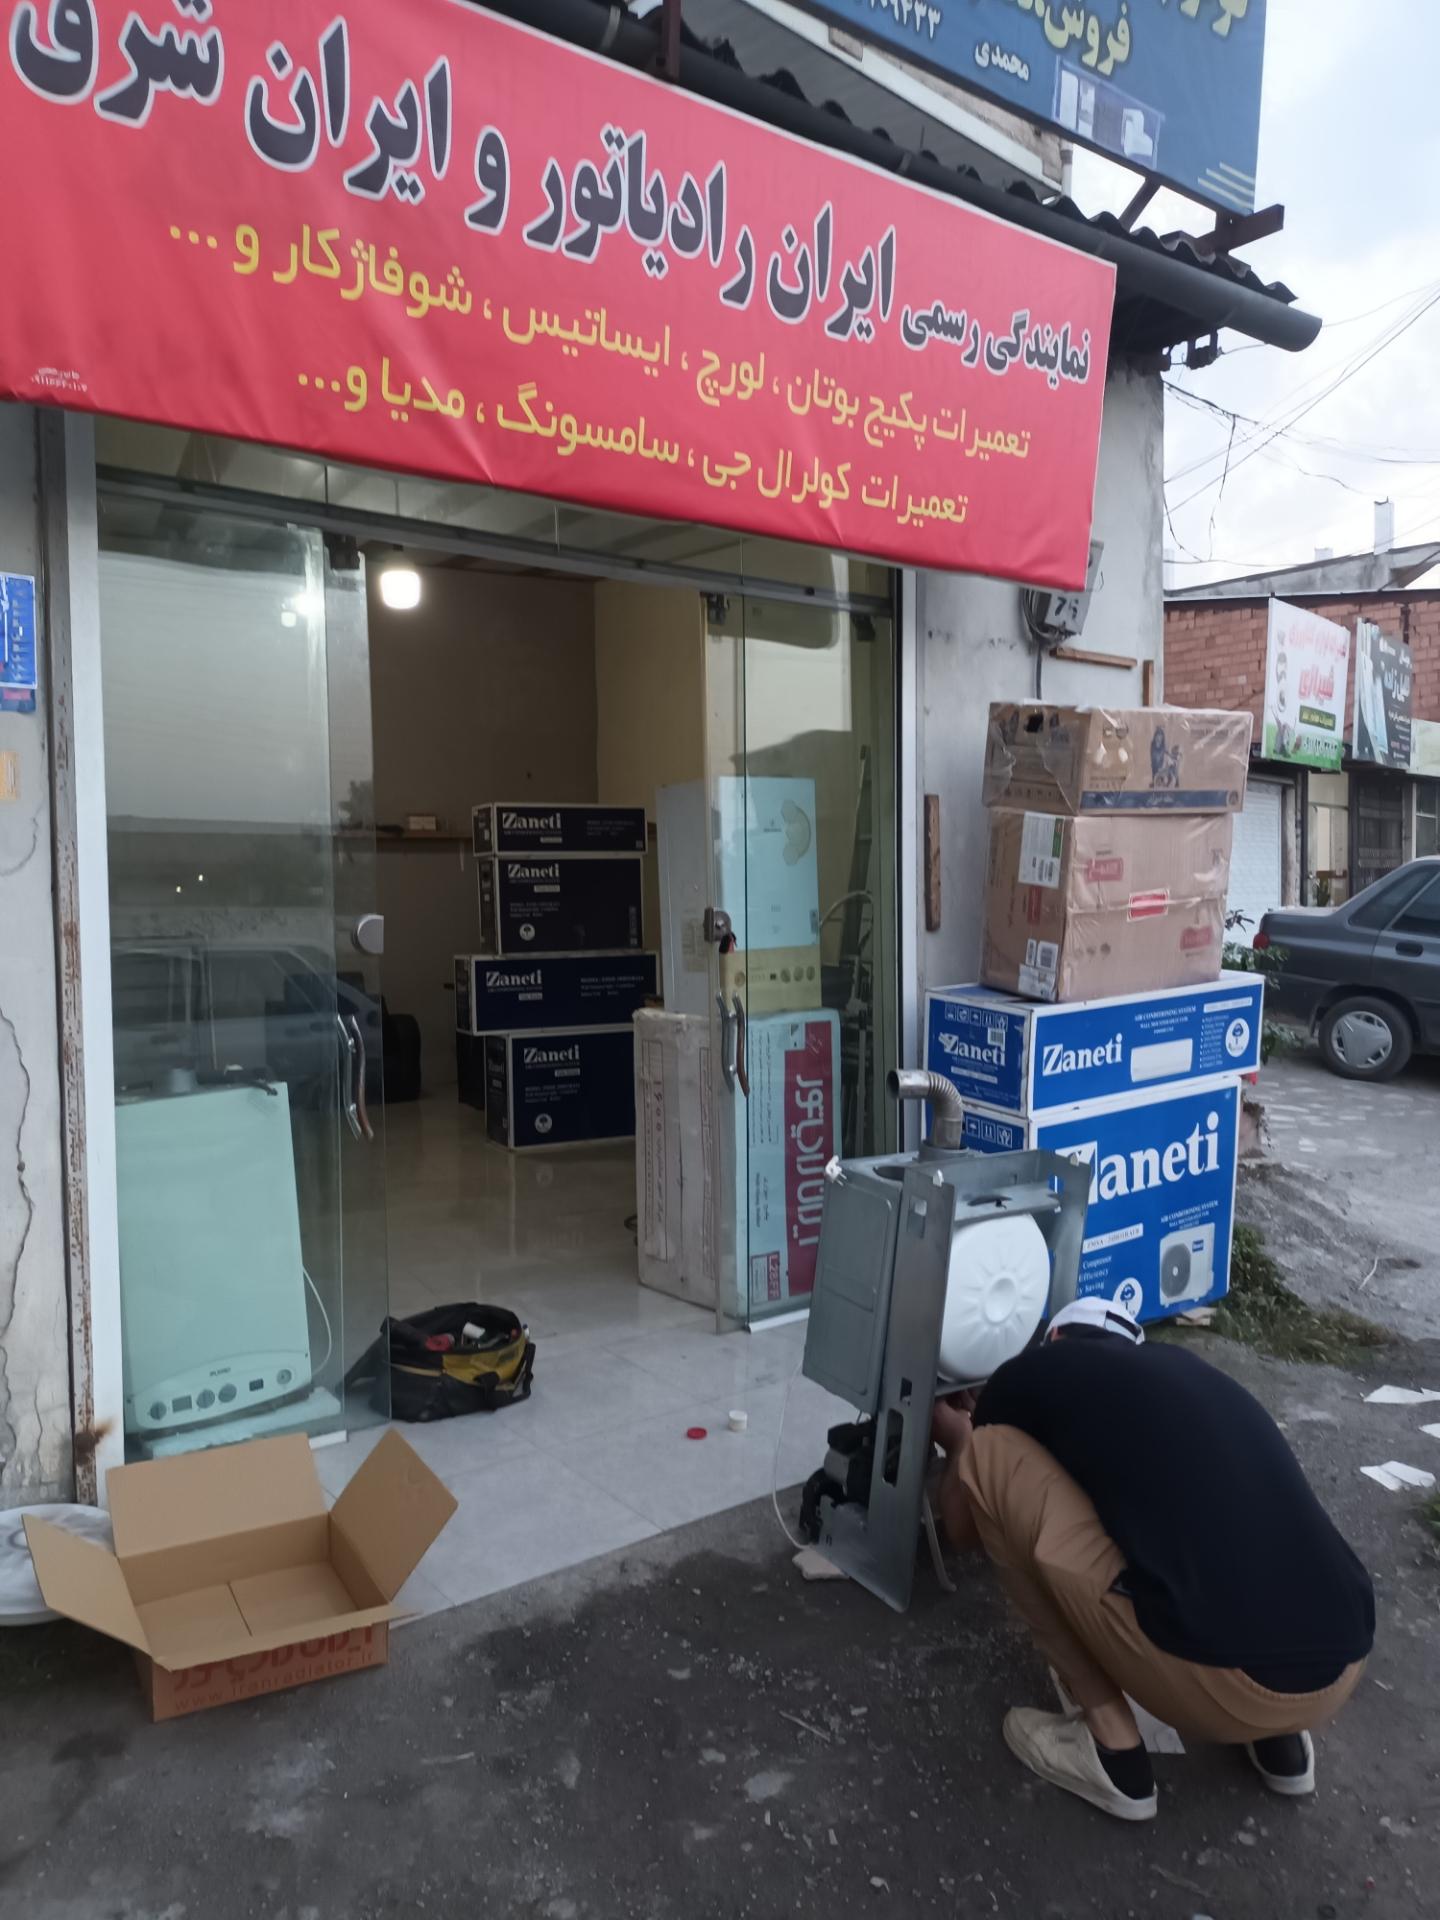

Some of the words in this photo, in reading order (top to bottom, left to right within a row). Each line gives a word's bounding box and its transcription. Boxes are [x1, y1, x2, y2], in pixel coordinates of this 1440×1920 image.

[975, 41, 1030, 82] محمدی
[244, 16, 452, 205] ایران
[464, 125, 510, 235] و
[522, 122, 755, 310] رادیاتور
[232, 224, 260, 275] و
[766, 198, 897, 342] ایران
[502, 304, 671, 380] ایساتیس
[901, 299, 979, 366] رسمی
[984, 308, 1092, 391] نمایندگی
[382, 357, 466, 423] مدیا
[696, 346, 766, 407] لورچ
[786, 367, 860, 426] بوتان
[495, 381, 681, 465] سامسونگ
[862, 391, 927, 451] پکیج
[932, 406, 1032, 459] تعمیرات
[702, 449, 752, 491] جی
[860, 471, 969, 528] تعمیرات
[502, 812, 562, 829] Zaneti
[507, 863, 560, 879] Zaneti
[486, 969, 543, 988] Zaneti
[523, 1044, 581, 1065] Zaneti
[940, 1032, 1006, 1067] Zaneti
[1042, 1032, 1124, 1077] Zaneti
[790, 1074, 825, 1178] رادیاتور
[793, 1181, 825, 1247] ایران
